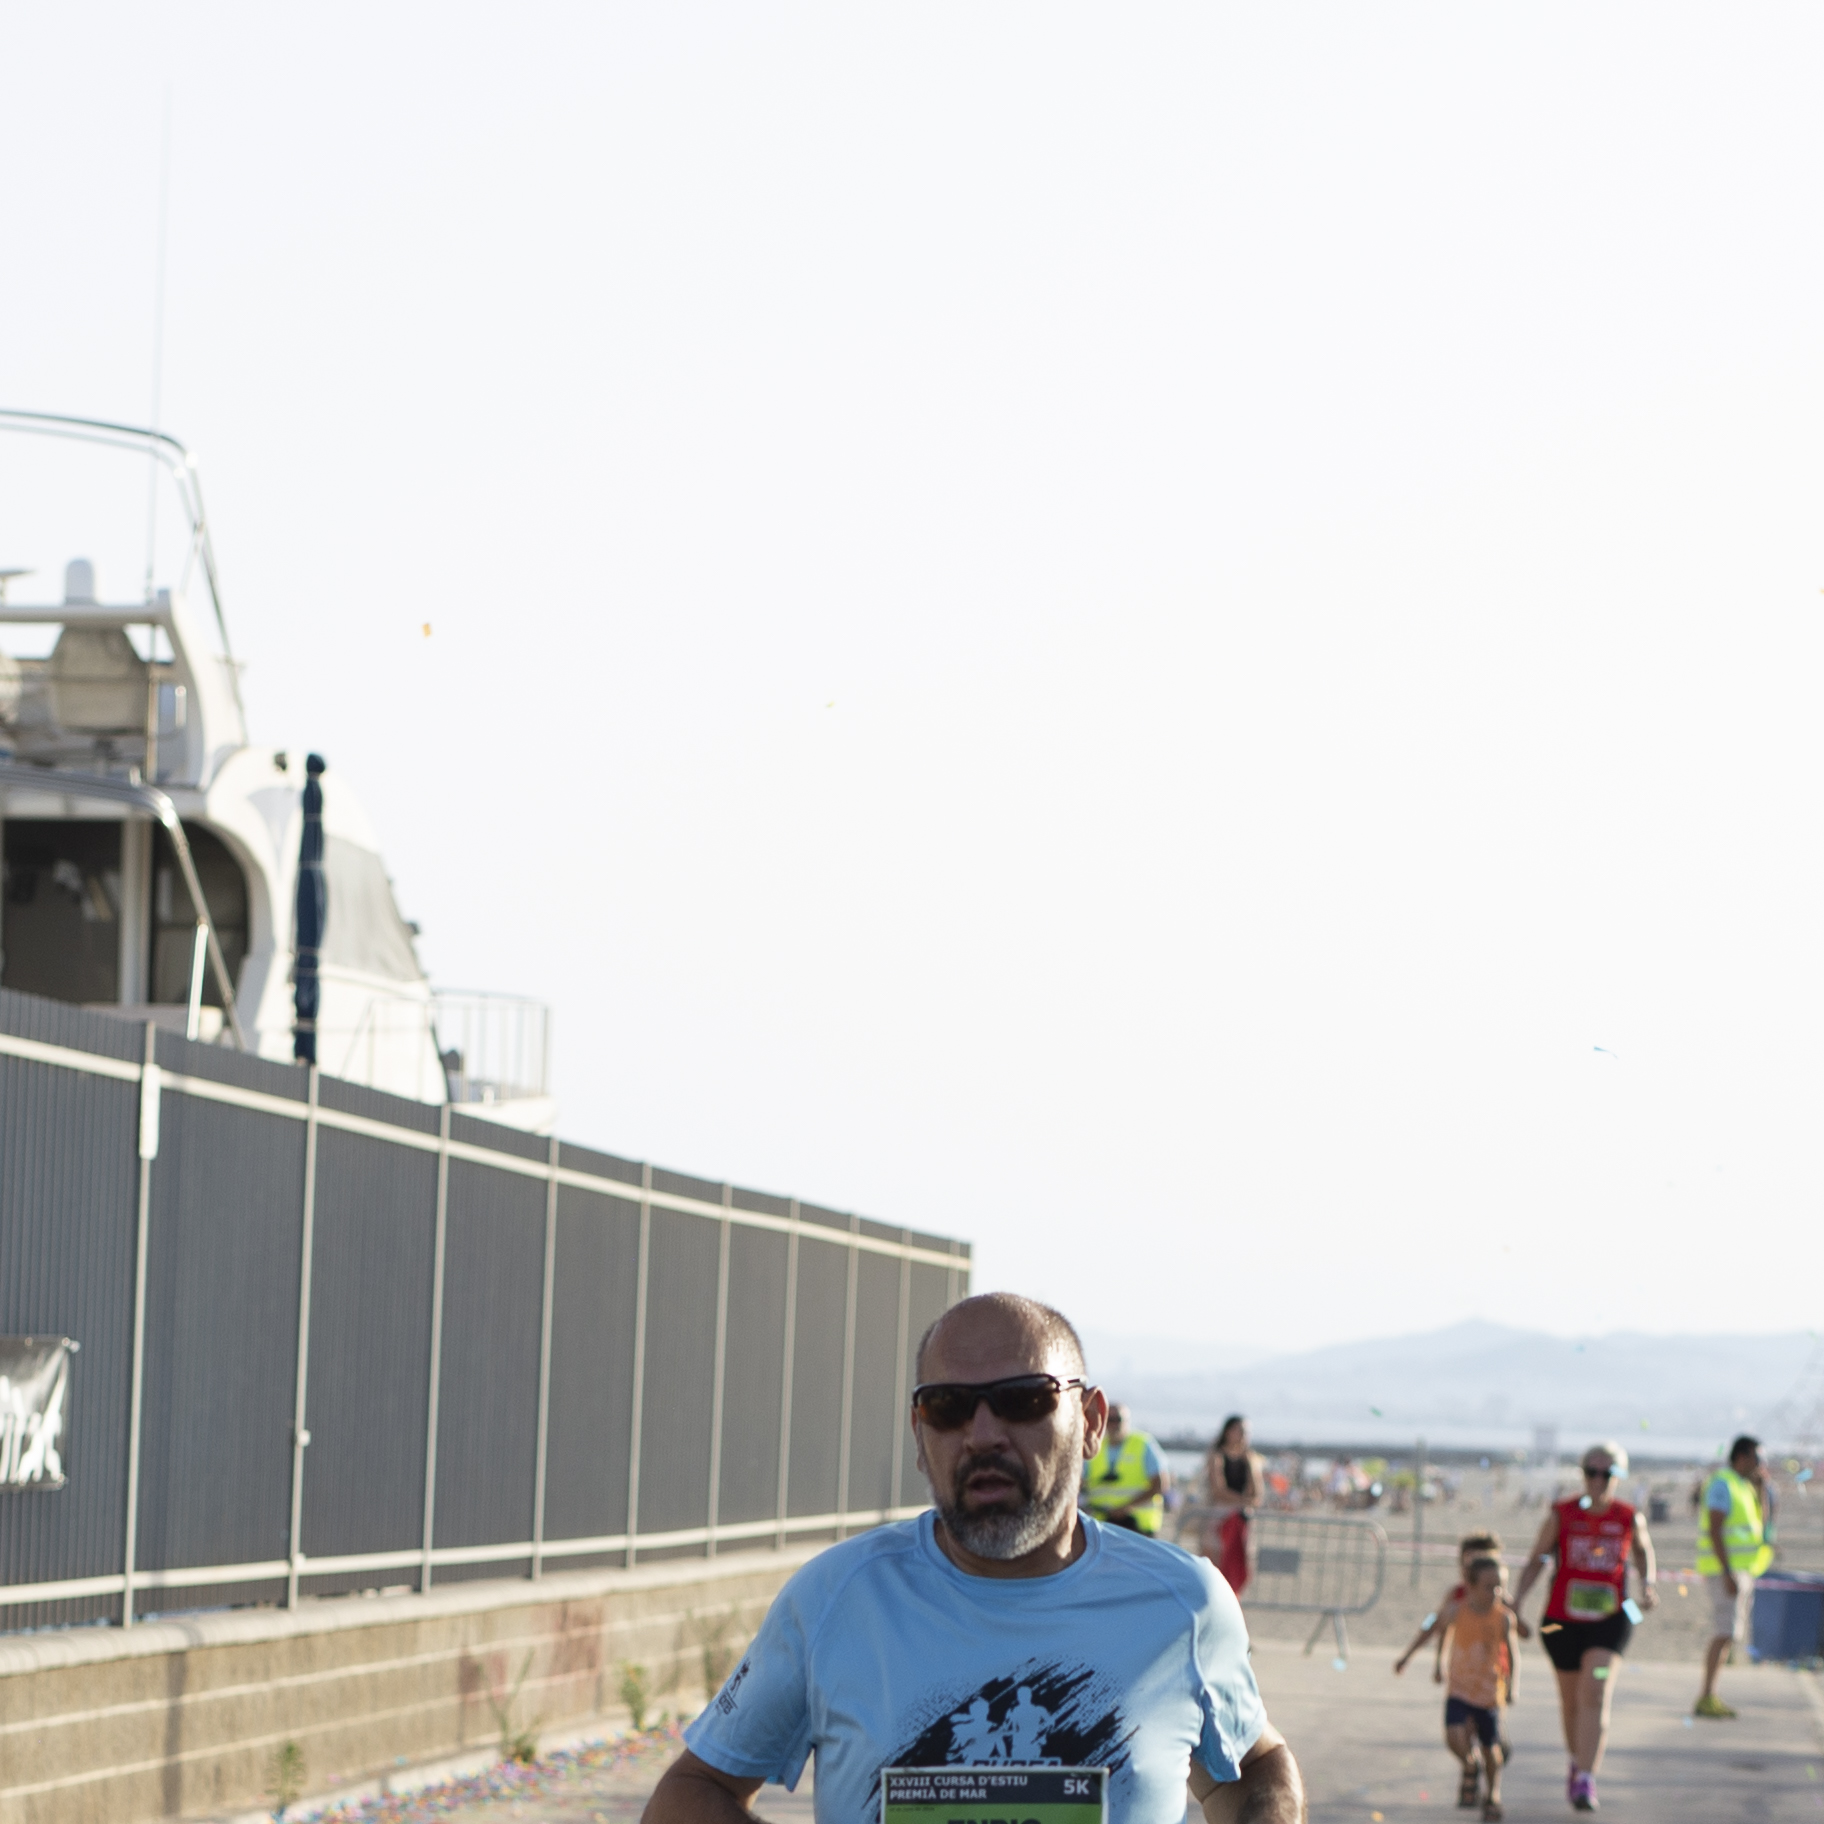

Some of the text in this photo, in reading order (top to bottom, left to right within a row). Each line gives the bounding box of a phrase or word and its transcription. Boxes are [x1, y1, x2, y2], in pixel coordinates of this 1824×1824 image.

[889, 1775, 1028, 1787] XXVIII CURSA D'ESTIU
[1063, 1779, 1090, 1795] 5K
[889, 1787, 987, 1800] PREMIÀ DE MAR
